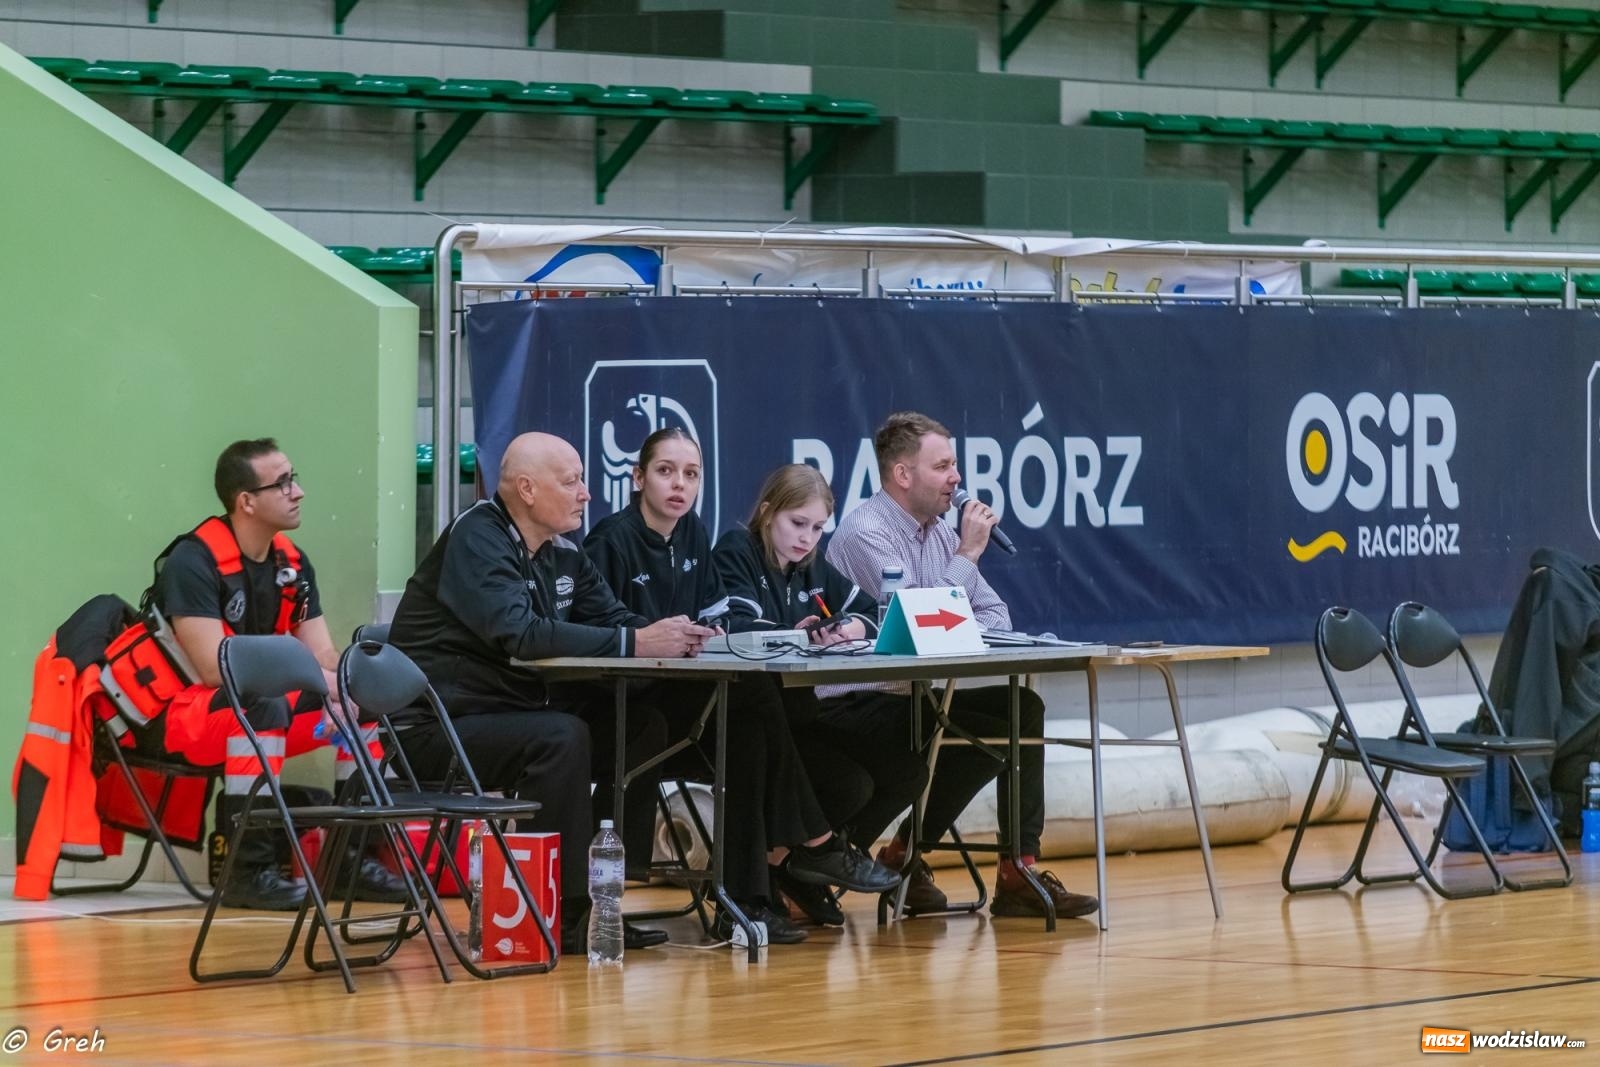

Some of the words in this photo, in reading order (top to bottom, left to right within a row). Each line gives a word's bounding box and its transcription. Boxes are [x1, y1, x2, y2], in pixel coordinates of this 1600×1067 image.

[792, 401, 1144, 533] RABÓRZ
[1358, 513, 1460, 558] RACIBÓRZ
[492, 849, 532, 930] 5
